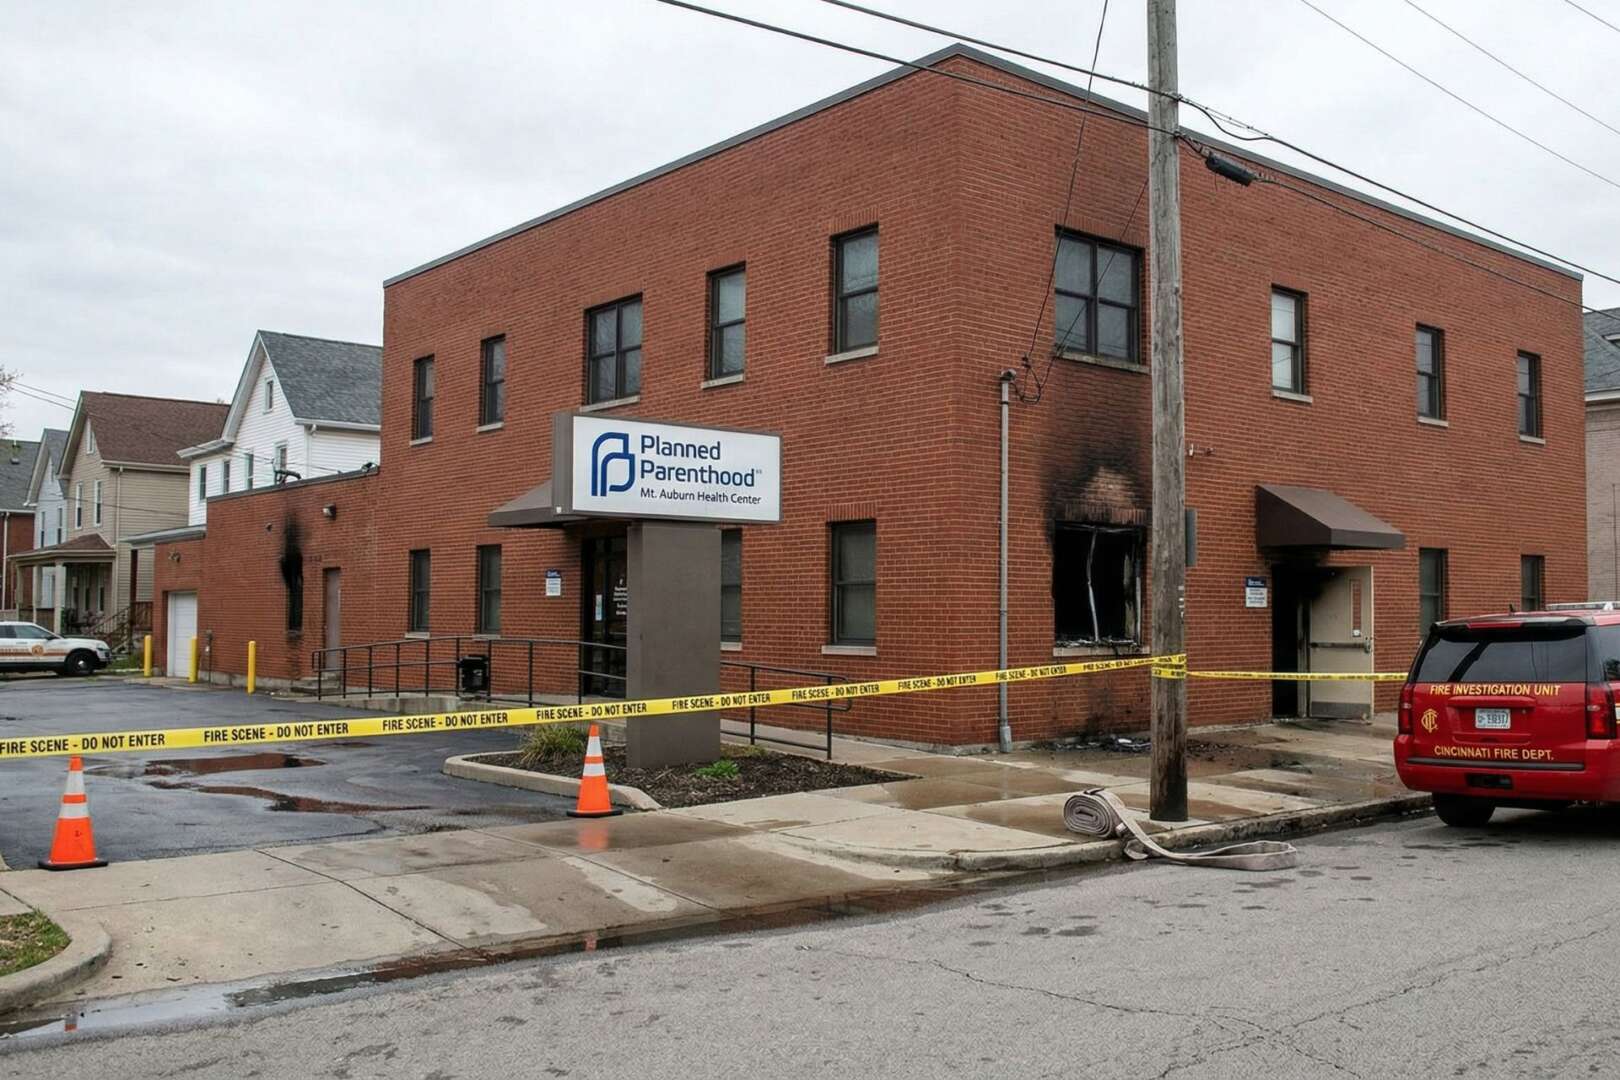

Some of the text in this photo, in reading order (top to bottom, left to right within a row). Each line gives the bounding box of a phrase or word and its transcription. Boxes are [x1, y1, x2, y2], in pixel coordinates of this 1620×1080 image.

[640, 434, 720, 460] Planned
[640, 460, 755, 487] Parenthood
[640, 488, 762, 505] Mt. Auburn Health Center
[860, 684, 879, 693] ENTER
[1430, 684, 1560, 696] FIRE INVESTIGATION UNIT
[672, 700, 689, 710] FIRE
[690, 698, 714, 709] SCENE
[721, 697, 730, 706] DO
[733, 696, 746, 705] NOT
[749, 693, 770, 704] ENTER
[536, 710, 554, 720] FIRE
[556, 708, 583, 719] SCENE
[592, 706, 602, 716] DO
[605, 705, 620, 715] NOT
[623, 703, 646, 714] ENTER
[382, 720, 403, 731] FIRE
[406, 718, 436, 729] SCENE
[446, 716, 457, 726] DO
[460, 714, 478, 726] NOT
[481, 712, 508, 724] ENTER
[204, 730, 228, 742] FIRE
[232, 728, 265, 741] SCENE
[277, 726, 291, 738] DO
[295, 724, 314, 736] NOT
[318, 723, 348, 735] ENTER
[0, 741, 26, 754] FIRE
[30, 739, 68, 752] SCENE
[82, 737, 98, 750] DO
[102, 736, 125, 748] NOT
[128, 734, 165, 747] ENTER
[1434, 745, 1554, 760] CINCINNATI FIRE DEPT.
